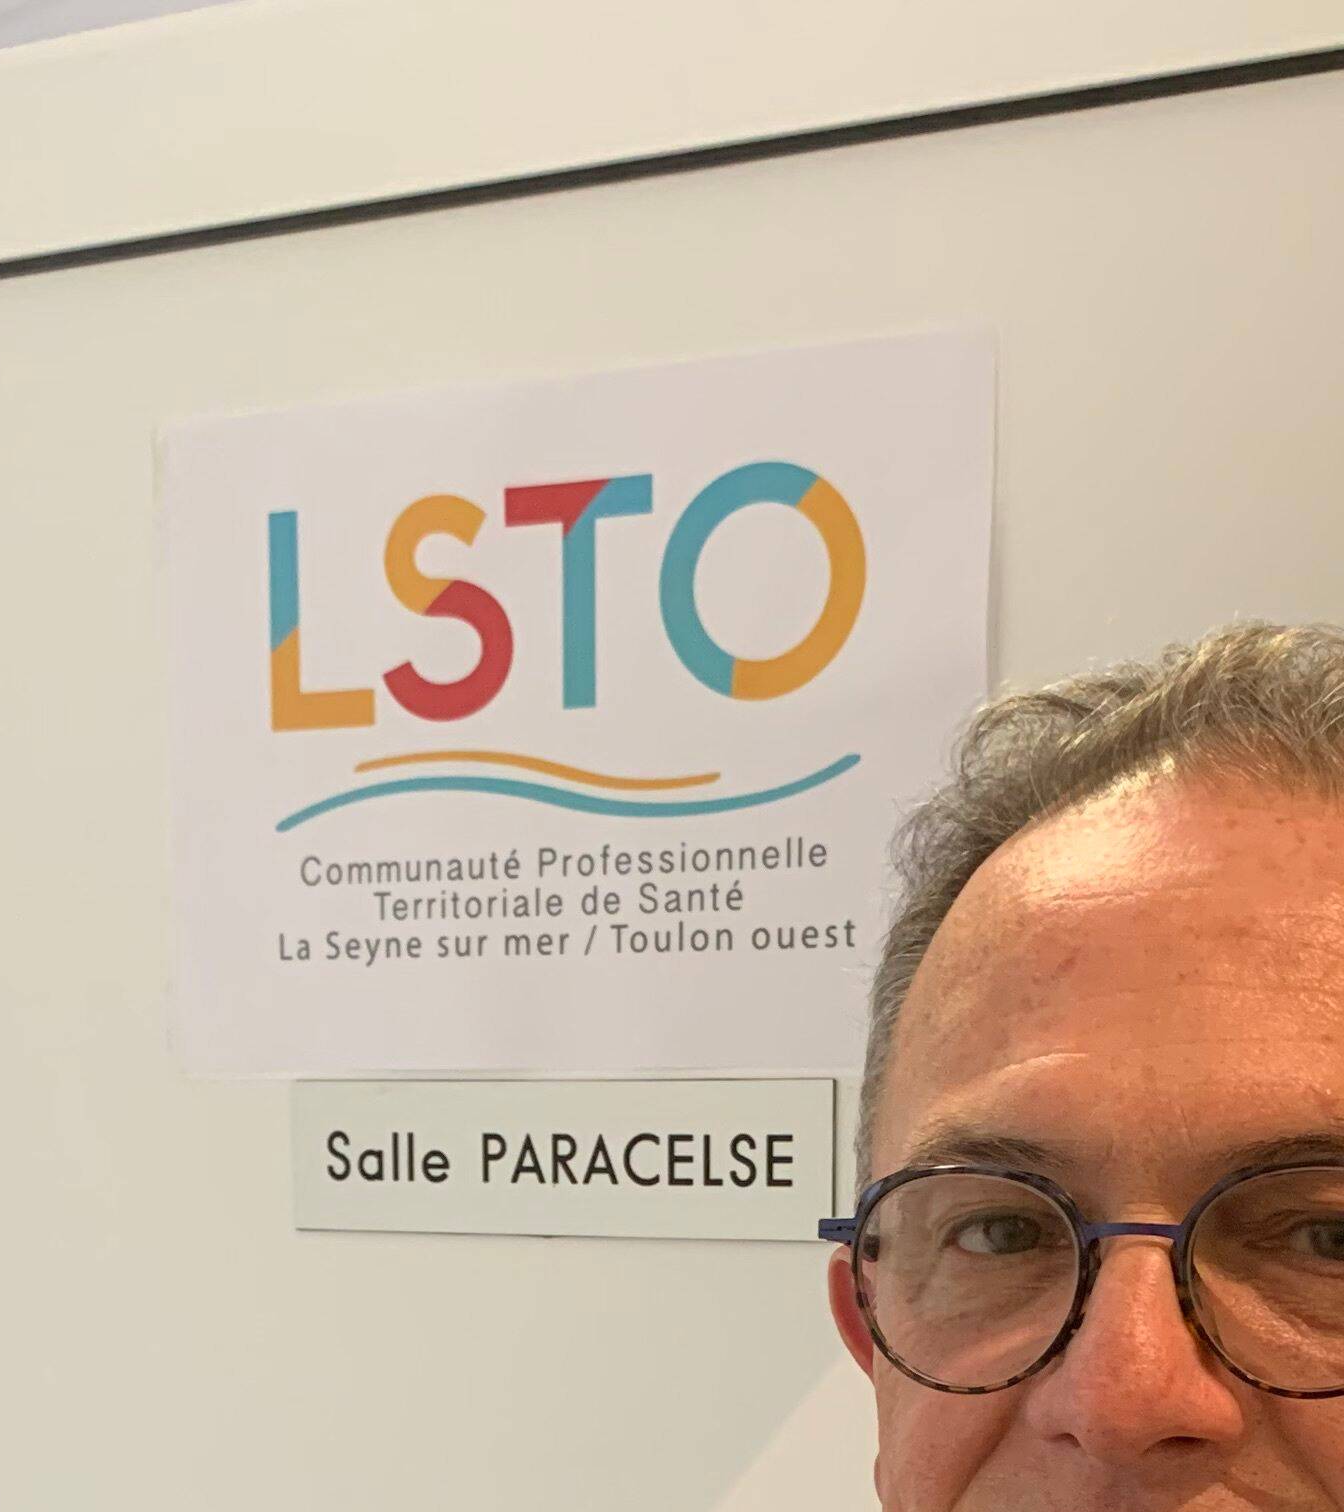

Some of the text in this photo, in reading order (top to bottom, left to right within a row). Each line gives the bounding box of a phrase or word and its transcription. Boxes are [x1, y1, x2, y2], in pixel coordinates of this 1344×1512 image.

[267, 460, 867, 733] LSTO
[299, 836, 828, 888] Communauté Professionnelle
[373, 871, 744, 921] Territoriale de Santé
[278, 919, 856, 967] La Seyne sur mer / Toulon ouest
[327, 1130, 794, 1188] Salle PARACELSE
